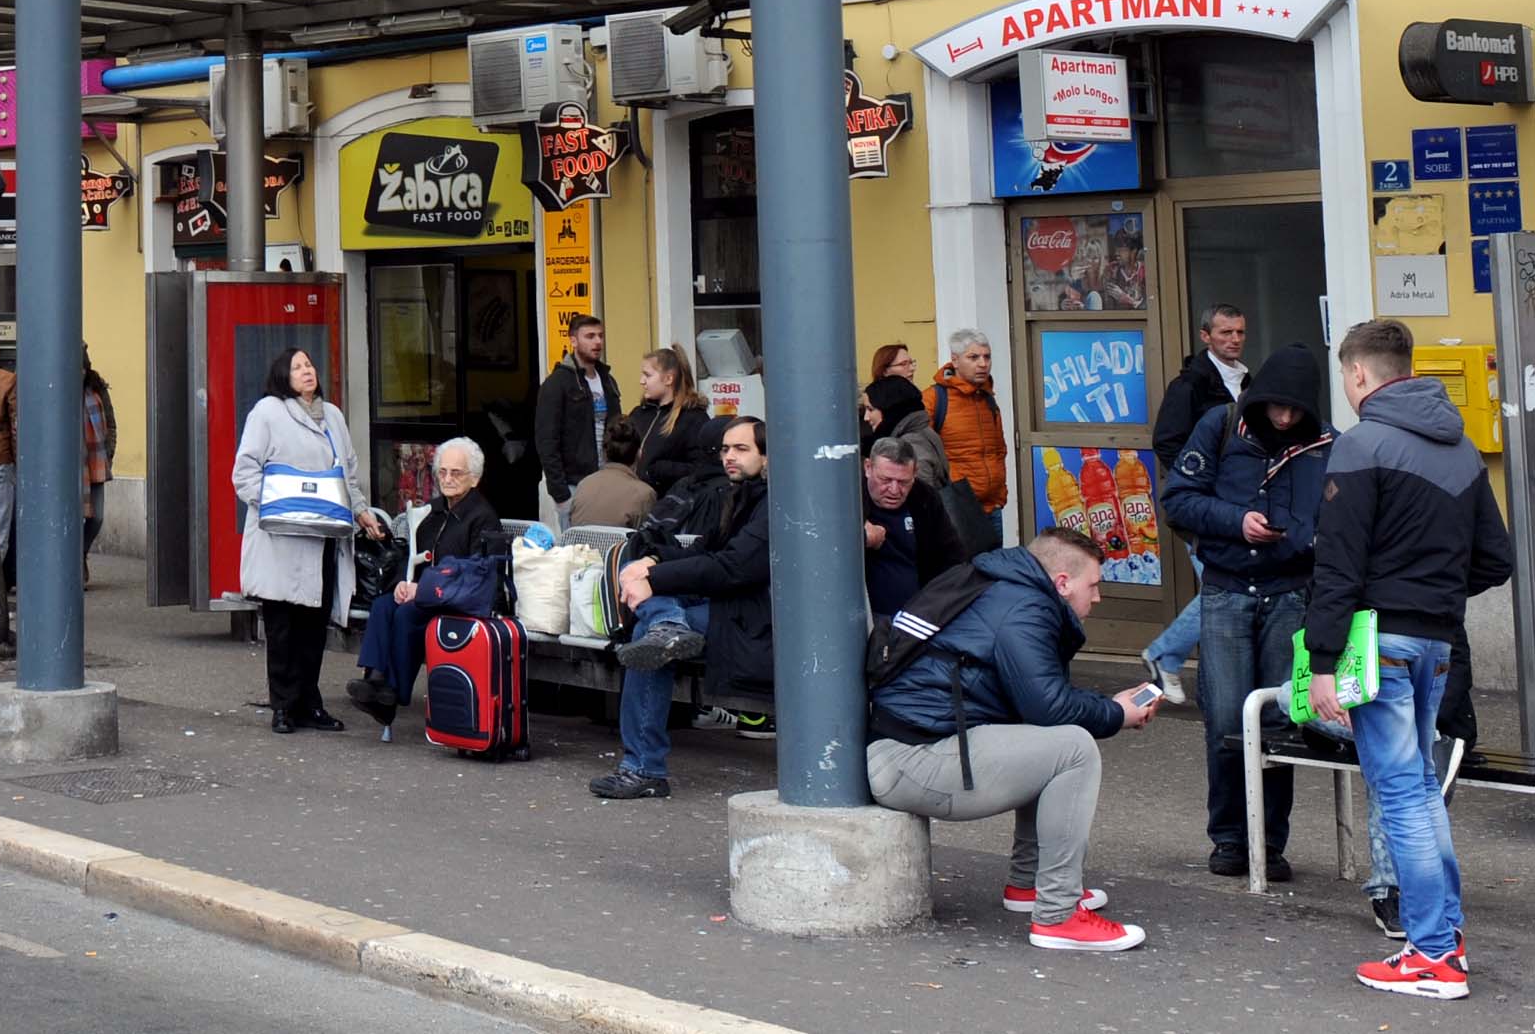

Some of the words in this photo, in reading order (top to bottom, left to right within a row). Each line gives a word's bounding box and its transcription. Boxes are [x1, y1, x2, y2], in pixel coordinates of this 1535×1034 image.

[1446, 30, 1516, 55] Bankomat
[1051, 57, 1116, 75] Apartmani
[1494, 66, 1518, 82] HPB
[542, 128, 589, 157] FAST
[551, 150, 607, 180] FOOD
[1384, 161, 1397, 181] 2
[1425, 164, 1452, 173] SOBE
[378, 162, 483, 212] Žabica
[413, 213, 442, 223] FAST
[447, 211, 482, 222] FOOD
[1390, 291, 1410, 299] Adria
[1414, 291, 1435, 299] Metal
